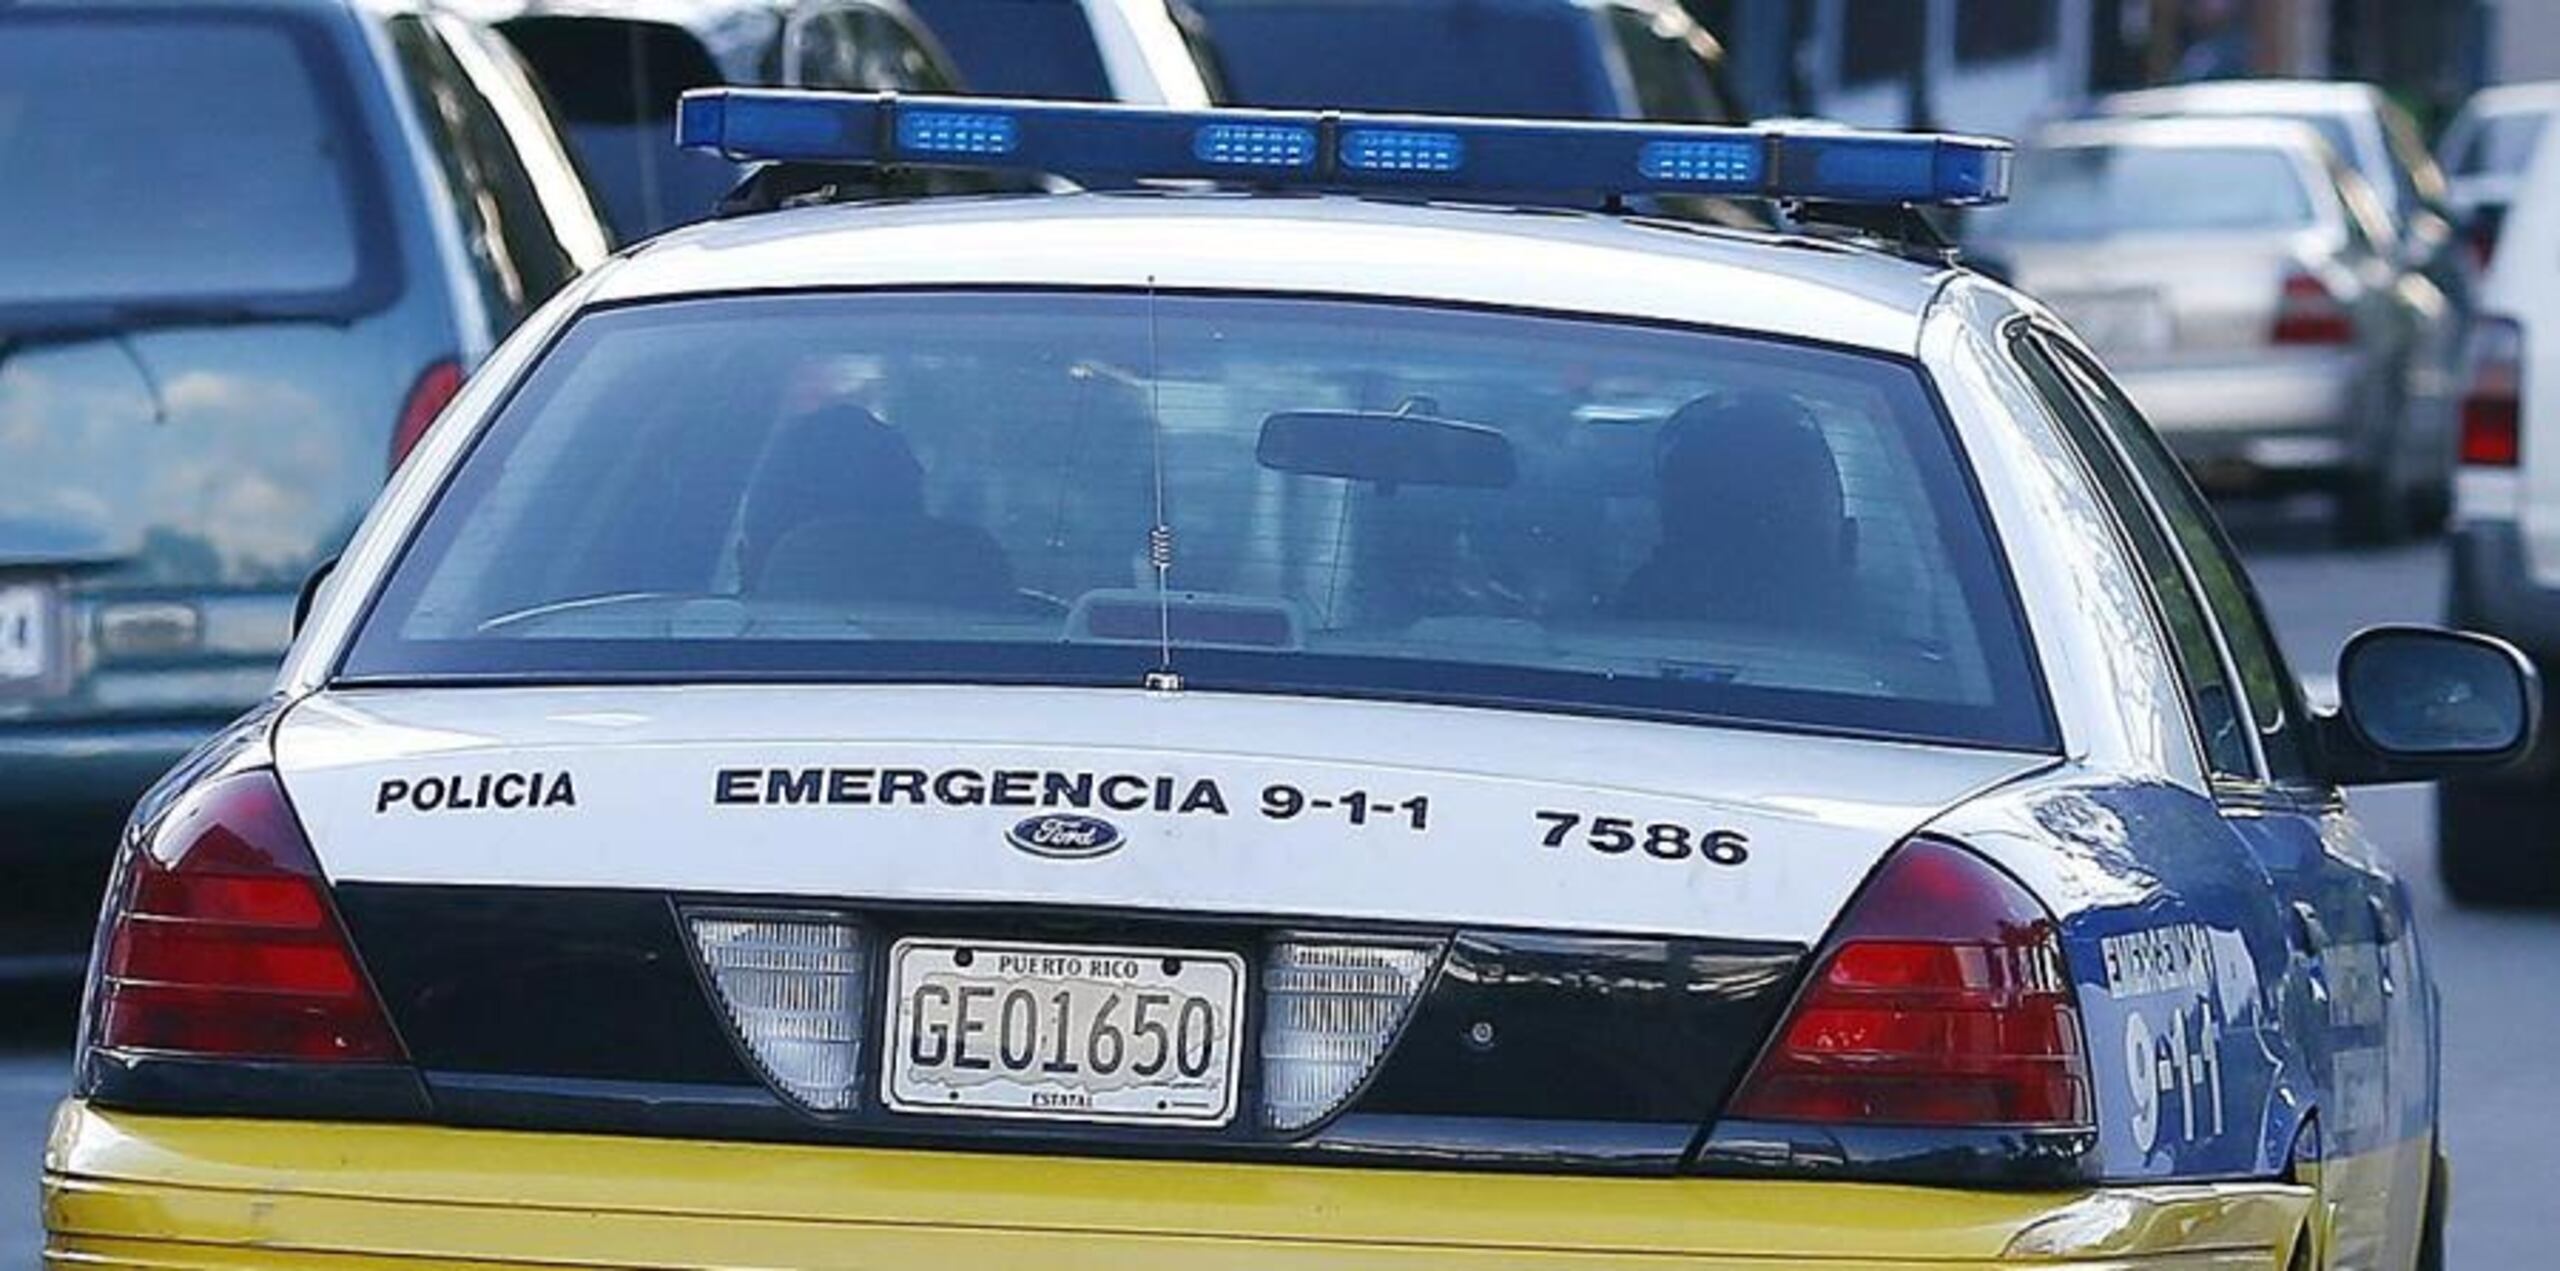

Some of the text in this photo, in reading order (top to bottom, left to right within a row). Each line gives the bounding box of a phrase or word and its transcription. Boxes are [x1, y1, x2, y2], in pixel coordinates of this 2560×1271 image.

[377, 771, 576, 812] POLICIA
[715, 769, 1430, 830] EMERGENCIA 9-1-1
[1033, 818, 1096, 845] Ford
[1535, 812, 1750, 866] 7586
[1000, 956, 1139, 979] PUERTO RICO
[2126, 1001, 2223, 1151] 9-1-1
[1032, 1092, 1093, 1107] ESTATAL
